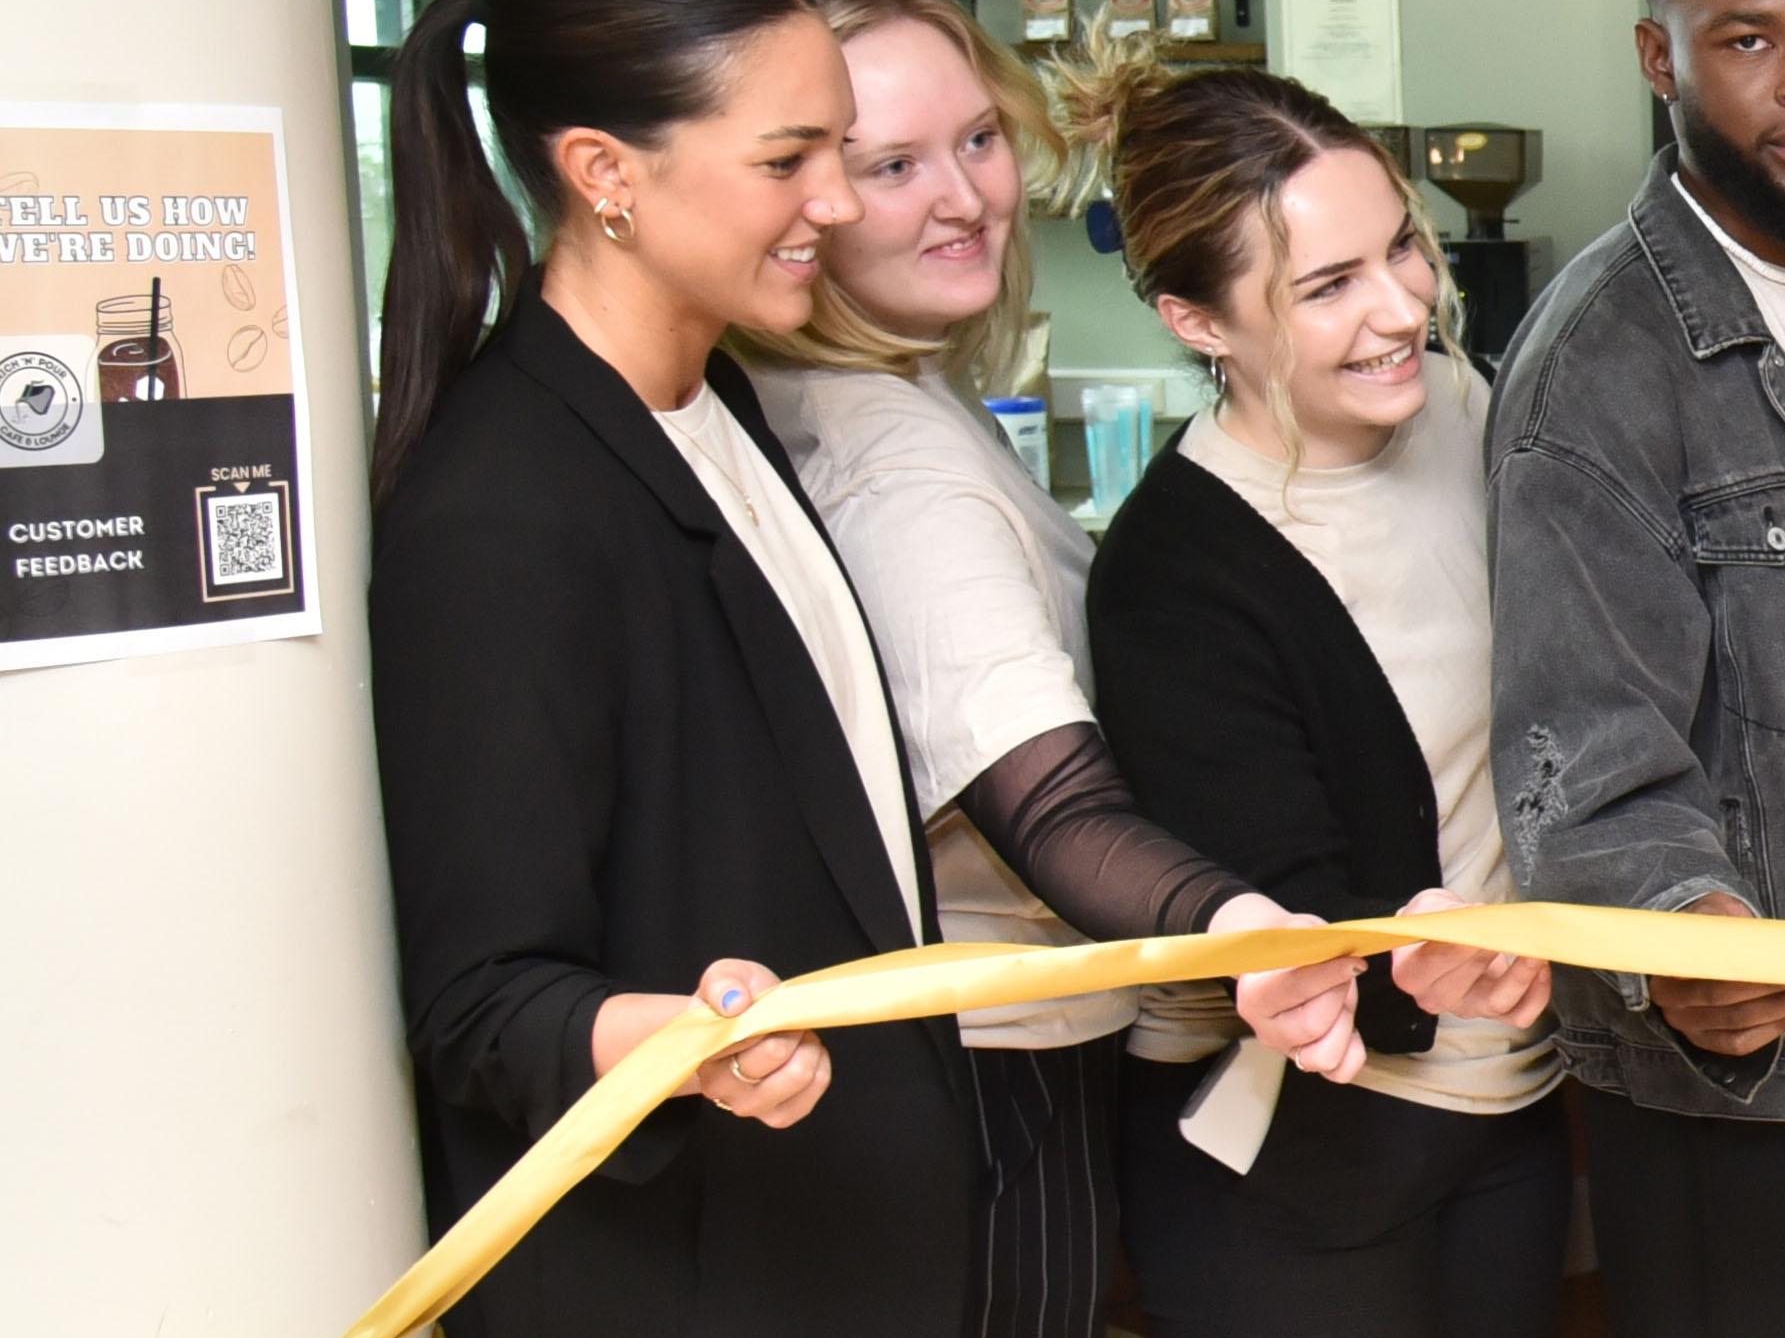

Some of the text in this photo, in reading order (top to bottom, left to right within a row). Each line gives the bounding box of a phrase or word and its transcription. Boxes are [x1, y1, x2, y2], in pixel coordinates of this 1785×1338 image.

[99, 195, 153, 227] US
[161, 195, 249, 227] HOW
[125, 230, 257, 264] DOING!
[38, 357, 68, 380] POUR
[0, 425, 24, 445] CAFE
[34, 423, 70, 446] LOUNGE
[210, 464, 273, 482] SCAN ME
[8, 514, 146, 546] CUSTOMER
[16, 549, 145, 579] FEEDBACK
